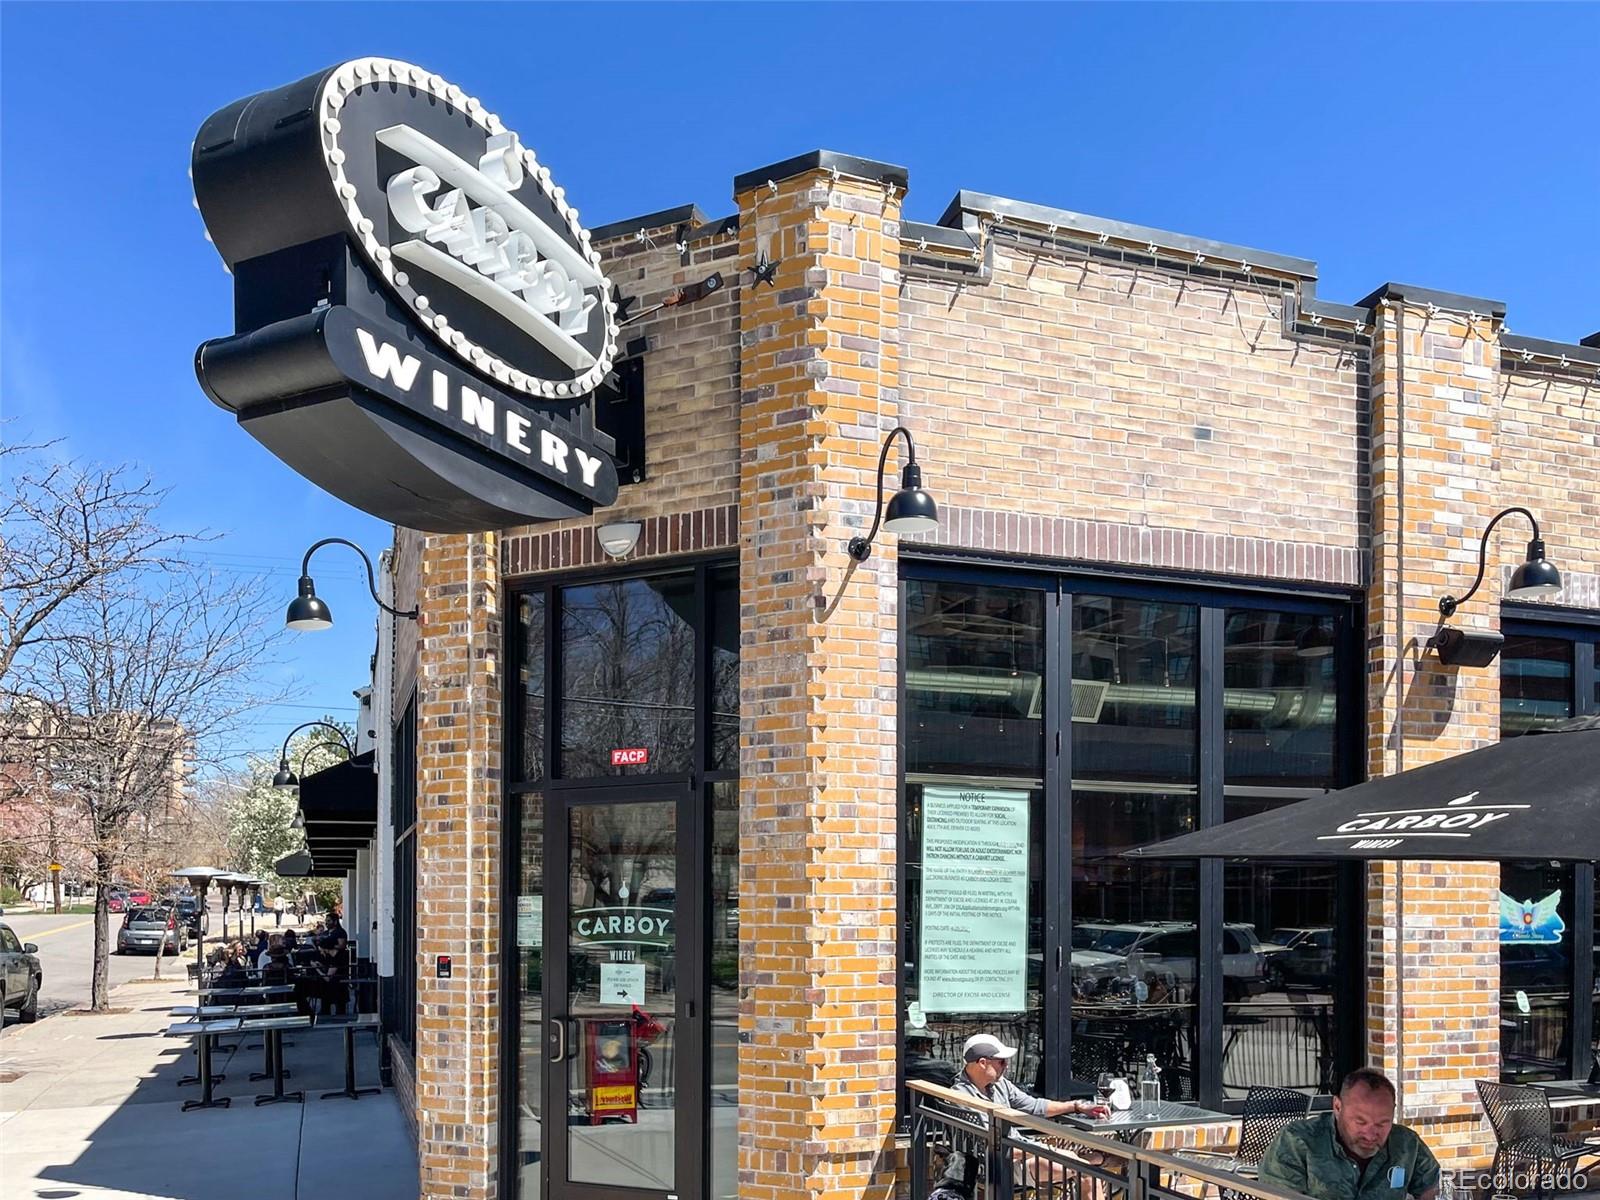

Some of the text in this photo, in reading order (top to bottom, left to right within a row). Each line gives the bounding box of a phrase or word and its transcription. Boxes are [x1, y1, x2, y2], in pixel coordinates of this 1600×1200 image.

[387, 165, 598, 337] CARBOY
[355, 327, 602, 488] WINERY
[614, 750, 645, 763] FACP
[959, 792, 986, 803] NOTICE
[1336, 812, 1510, 833] CARBOY
[577, 915, 670, 937] CARBOY
[609, 950, 636, 961] WINERY
